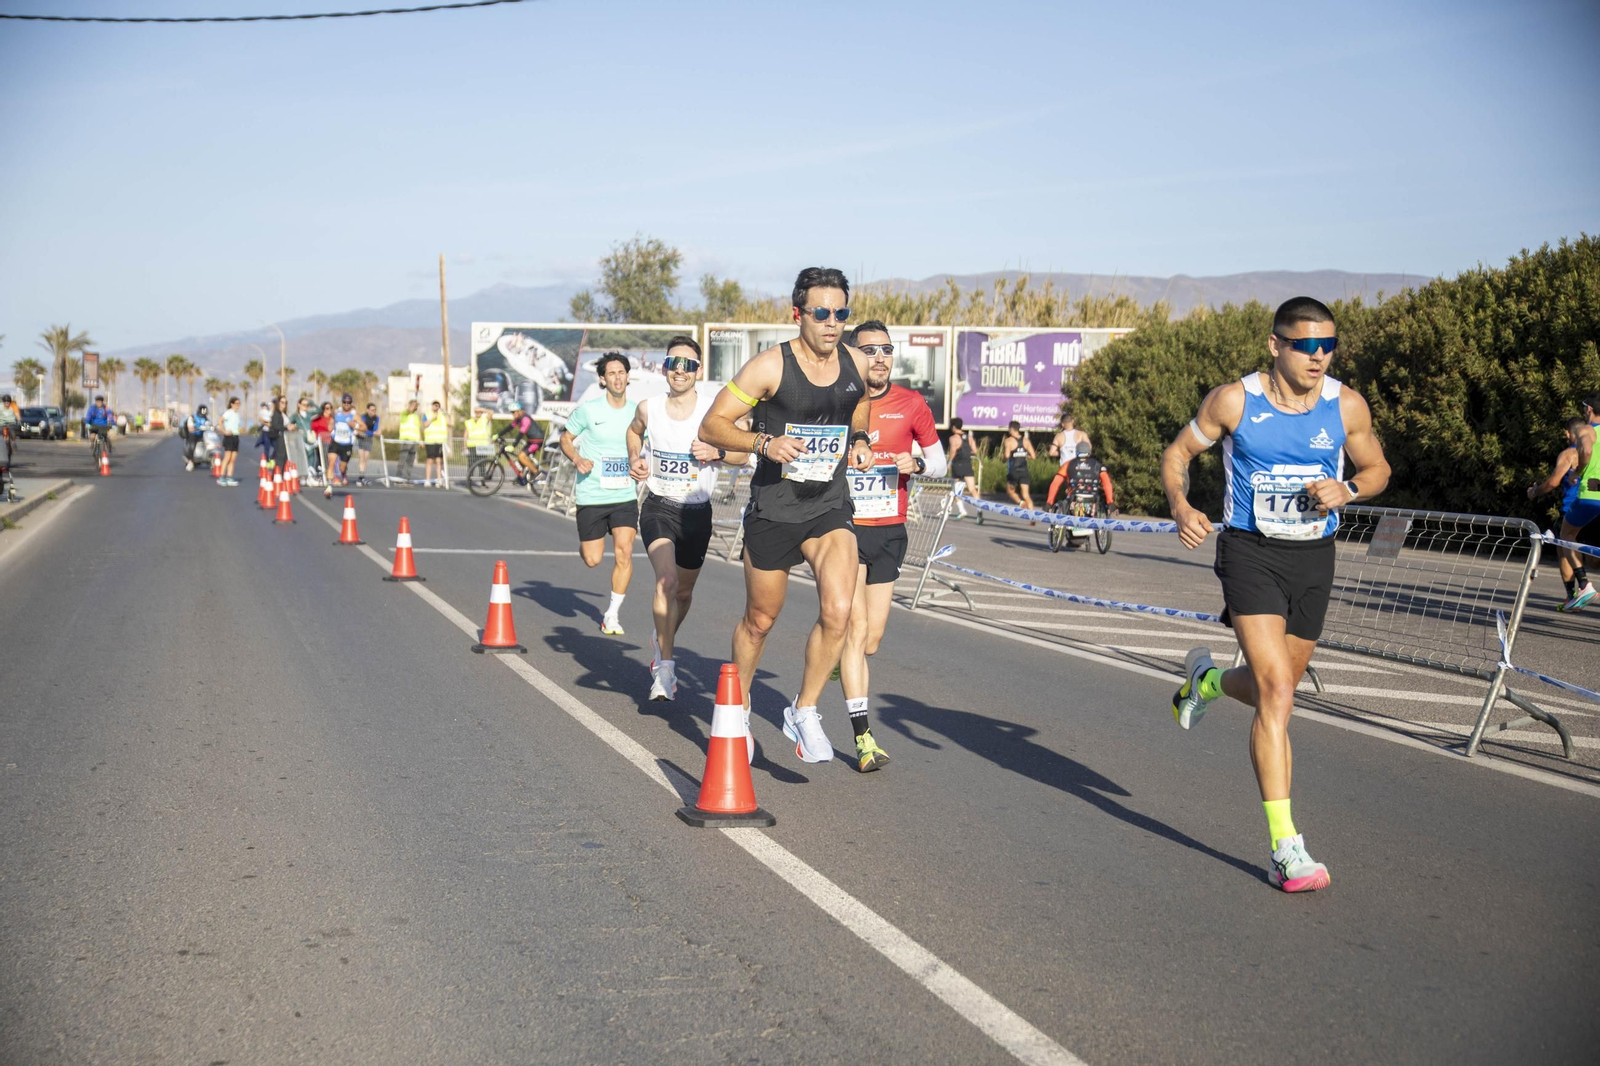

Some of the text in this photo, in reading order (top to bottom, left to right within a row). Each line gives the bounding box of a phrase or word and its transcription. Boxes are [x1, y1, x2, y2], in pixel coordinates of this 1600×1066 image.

[912, 336, 941, 344] Miele
[980, 341, 1027, 366] FIBRA
[1053, 339, 1082, 366] MÓ
[972, 405, 998, 419] 1790
[1012, 403, 1022, 413] C/
[795, 437, 840, 454] 466
[605, 462, 630, 472] 2065
[660, 460, 689, 474] 528
[854, 476, 887, 491] 571
